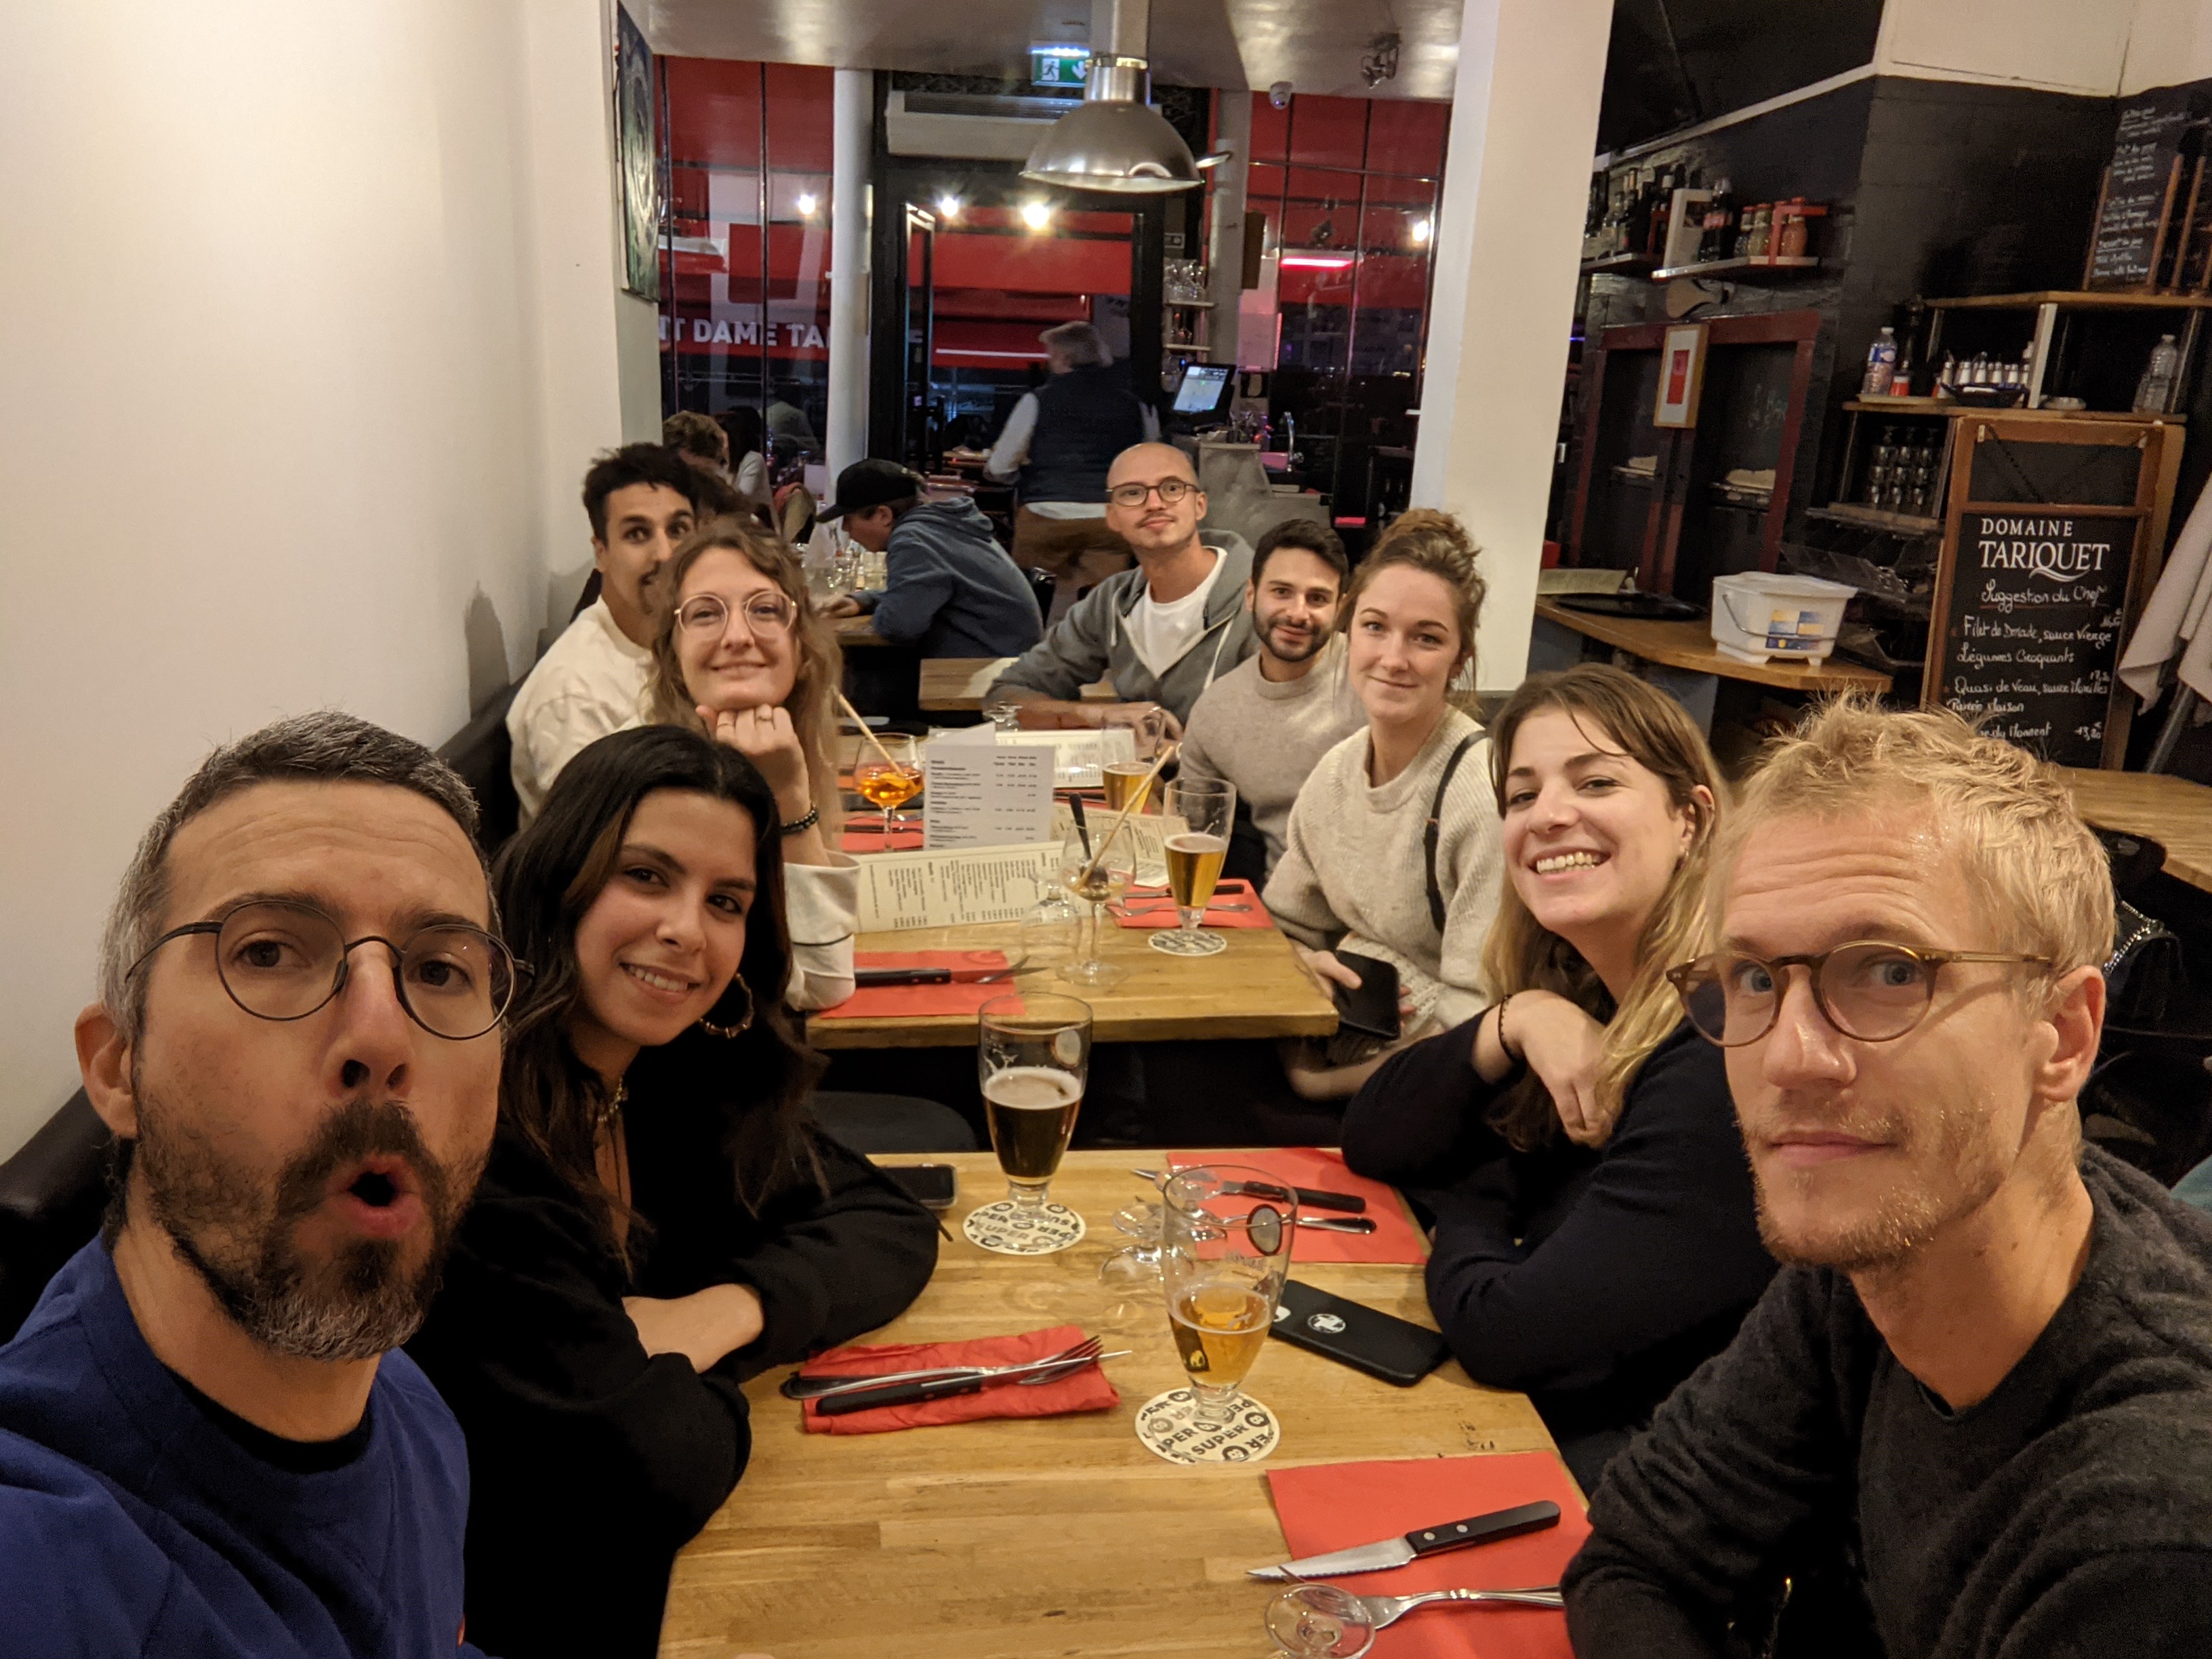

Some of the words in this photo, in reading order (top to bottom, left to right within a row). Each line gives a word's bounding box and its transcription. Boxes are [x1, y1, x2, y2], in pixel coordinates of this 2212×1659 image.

[693, 319, 778, 346] DAME
[785, 323, 830, 349] TA
[1981, 518, 2074, 537] DOMAINE
[1978, 540, 2110, 582] TARIQUET
[1980, 578, 2050, 614] Suggestion
[2051, 588, 2070, 603] du
[1963, 615, 1990, 638] Filet
[2043, 630, 2074, 641] sauce
[2076, 623, 2112, 649] Vierge
[1956, 642, 2013, 670] Légumes
[1995, 678, 2010, 693] de
[2042, 682, 2070, 693] sauce
[1191, 1422, 1250, 1456] SUPER
